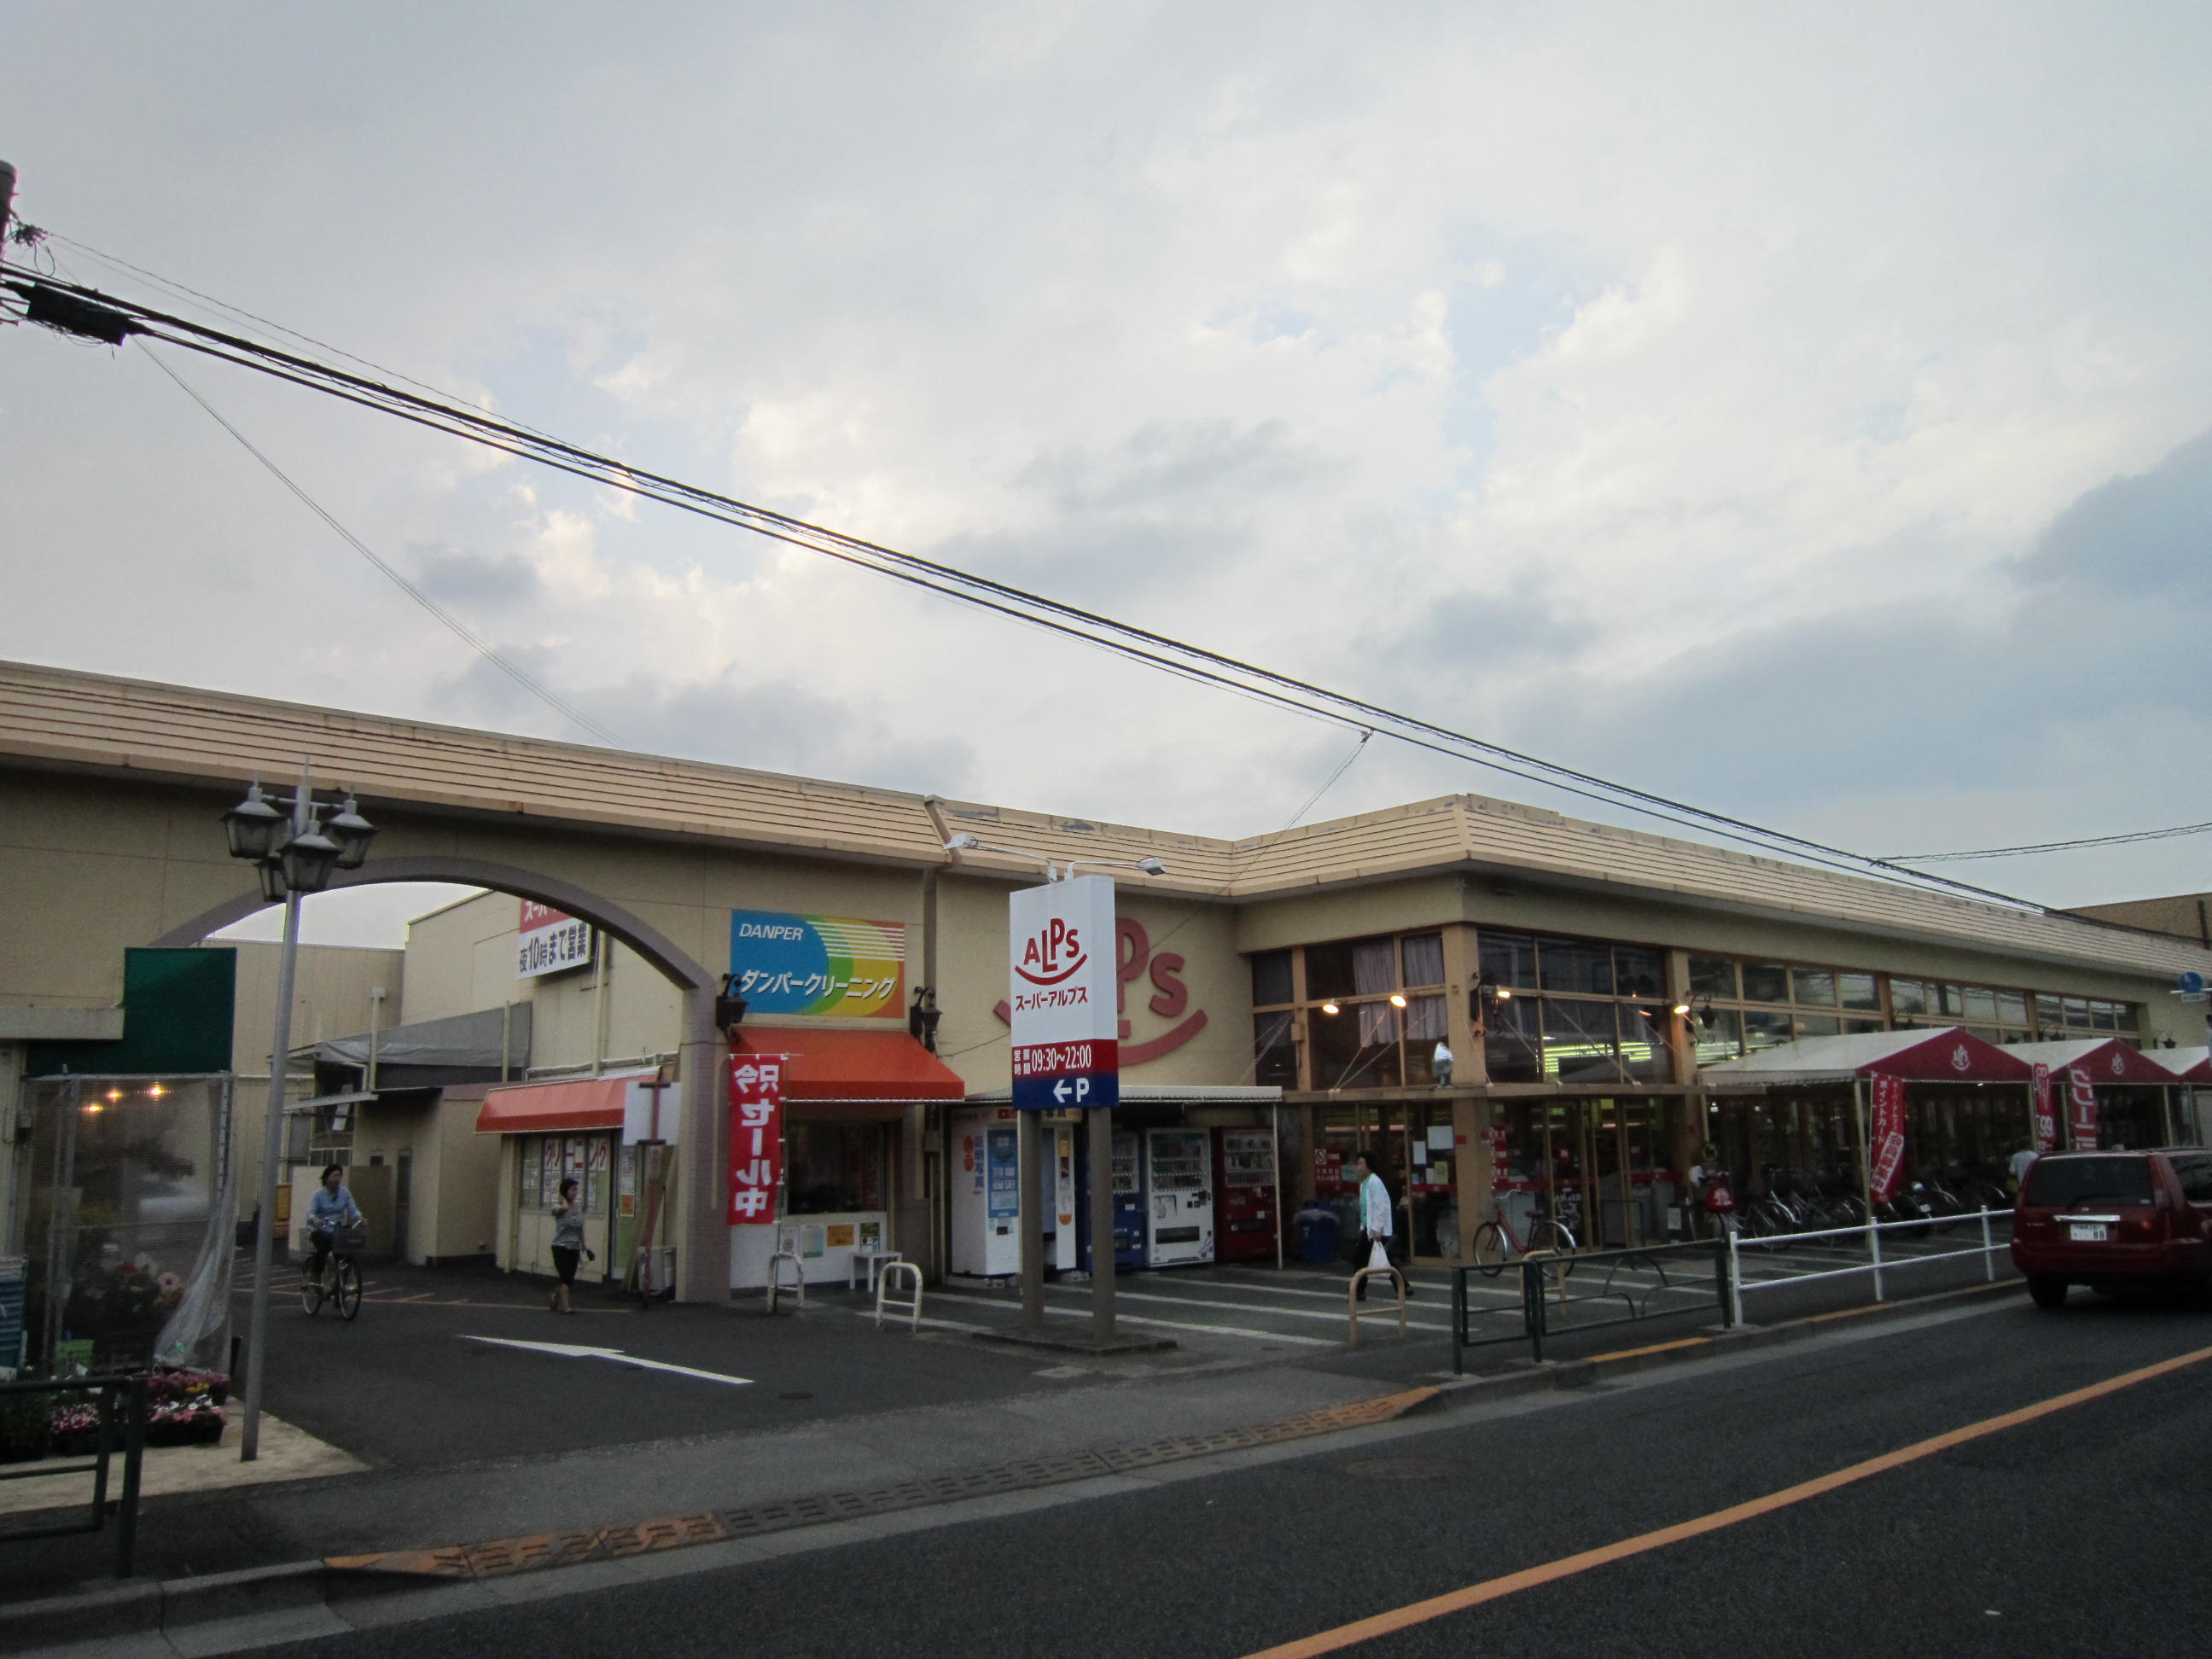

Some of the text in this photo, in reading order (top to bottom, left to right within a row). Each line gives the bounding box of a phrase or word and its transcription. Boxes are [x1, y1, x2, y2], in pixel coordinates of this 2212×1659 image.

[739, 923, 805, 941] DANPER
[1023, 917, 1080, 973] ALPS
[519, 922, 588, 973] 夜10時まで営業
[741, 969, 896, 999] ダンパークリーニング
[1016, 986, 1089, 1011] スーパーアルプス
[1076, 1078, 1090, 1103] P
